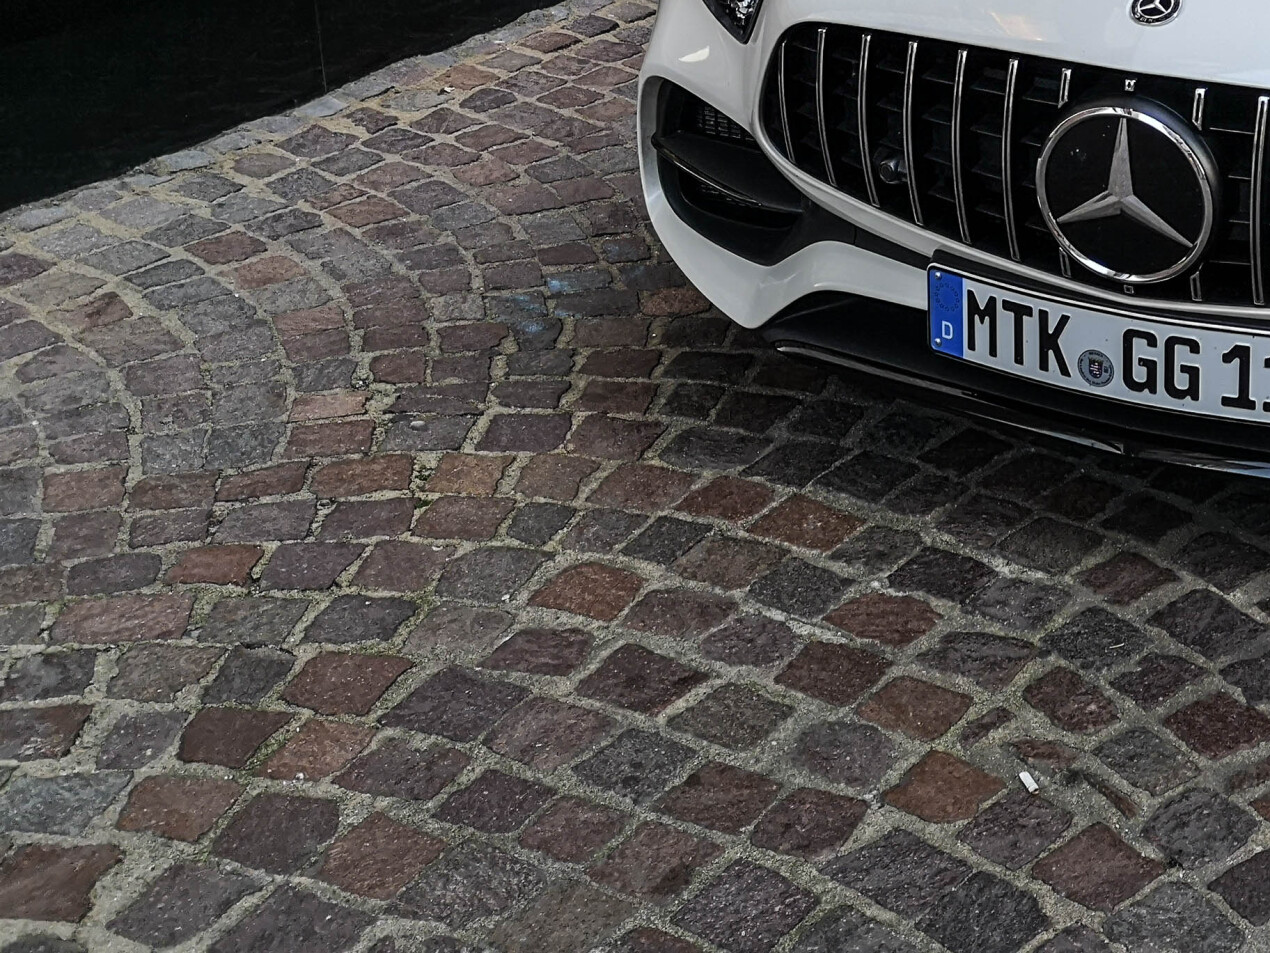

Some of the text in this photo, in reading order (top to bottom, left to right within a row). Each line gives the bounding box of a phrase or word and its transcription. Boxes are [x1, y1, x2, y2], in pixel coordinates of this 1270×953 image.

[941, 320, 954, 340] D
[967, 288, 1072, 378] MTK
[1122, 328, 1201, 402] GG
